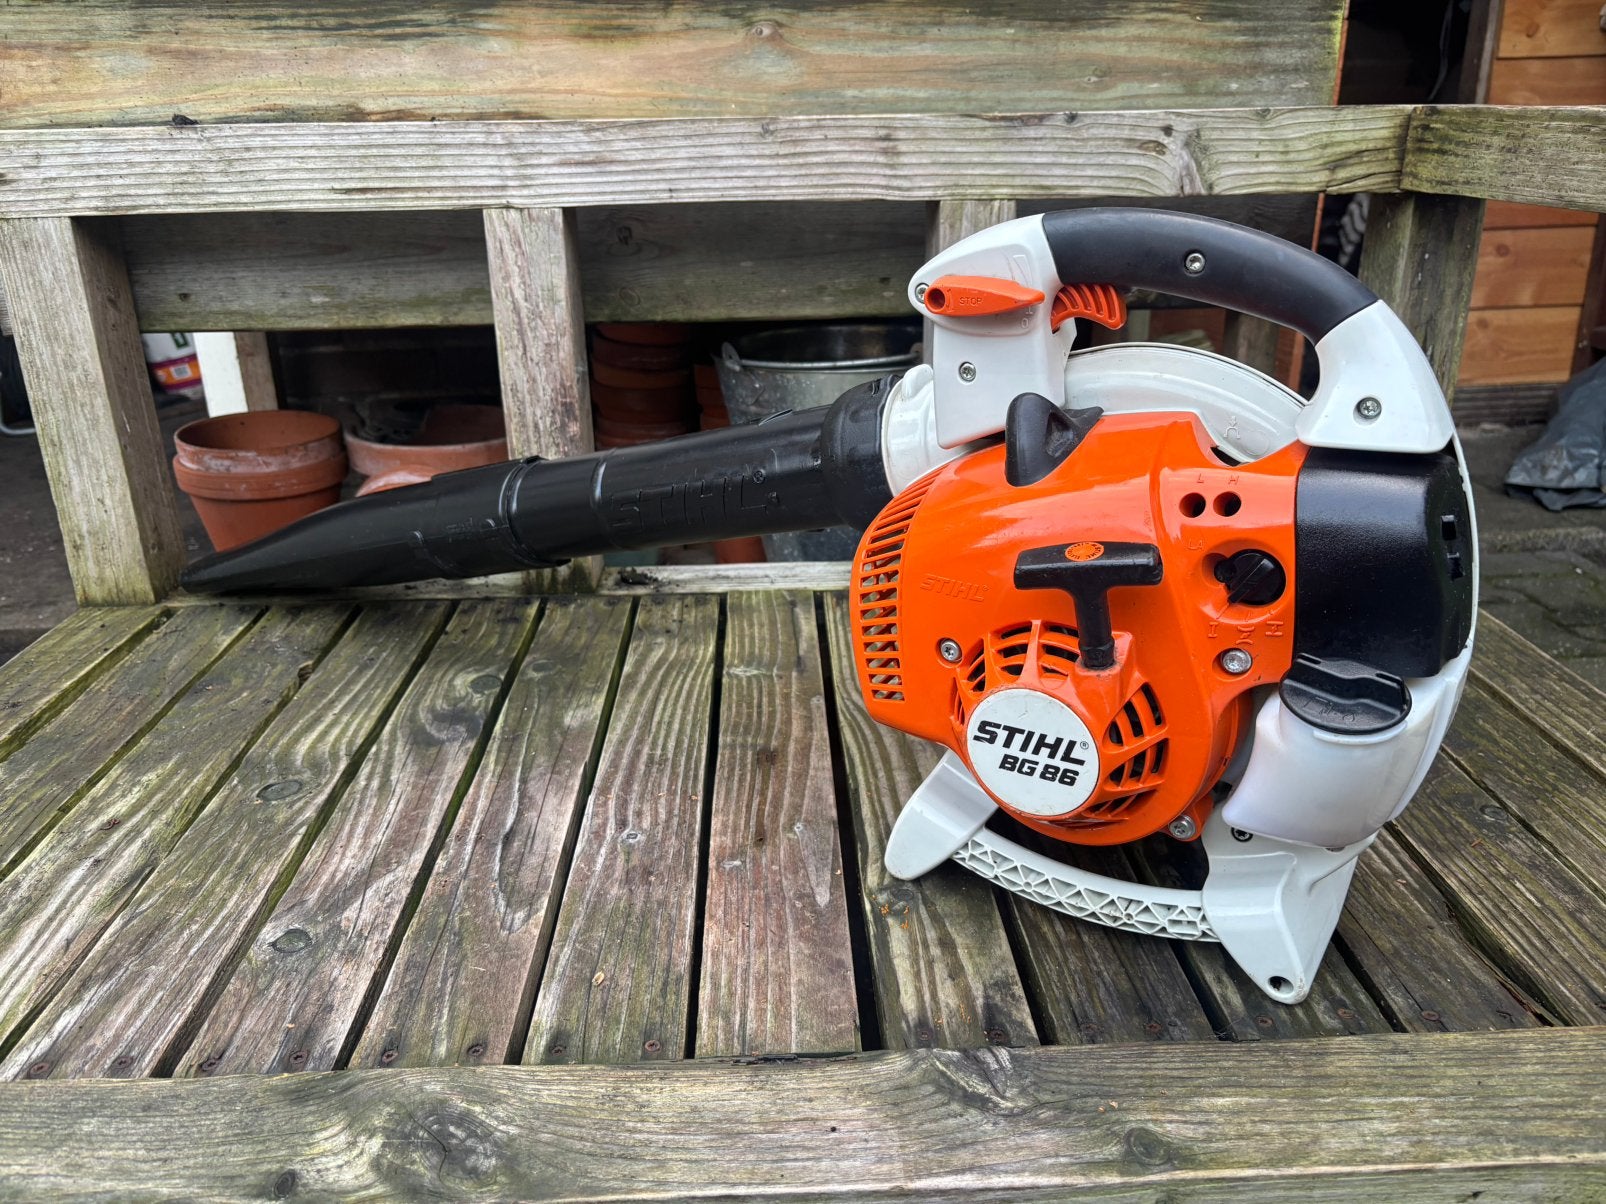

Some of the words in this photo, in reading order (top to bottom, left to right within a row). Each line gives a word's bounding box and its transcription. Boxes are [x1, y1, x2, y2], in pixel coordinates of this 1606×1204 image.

[959, 296, 983, 306] STOP
[1196, 473, 1204, 484] L
[1228, 475, 1240, 485] H
[919, 574, 985, 603] STIHL
[973, 720, 1086, 766] STIHL
[998, 753, 1040, 777] BG
[1039, 763, 1080, 787] 86
